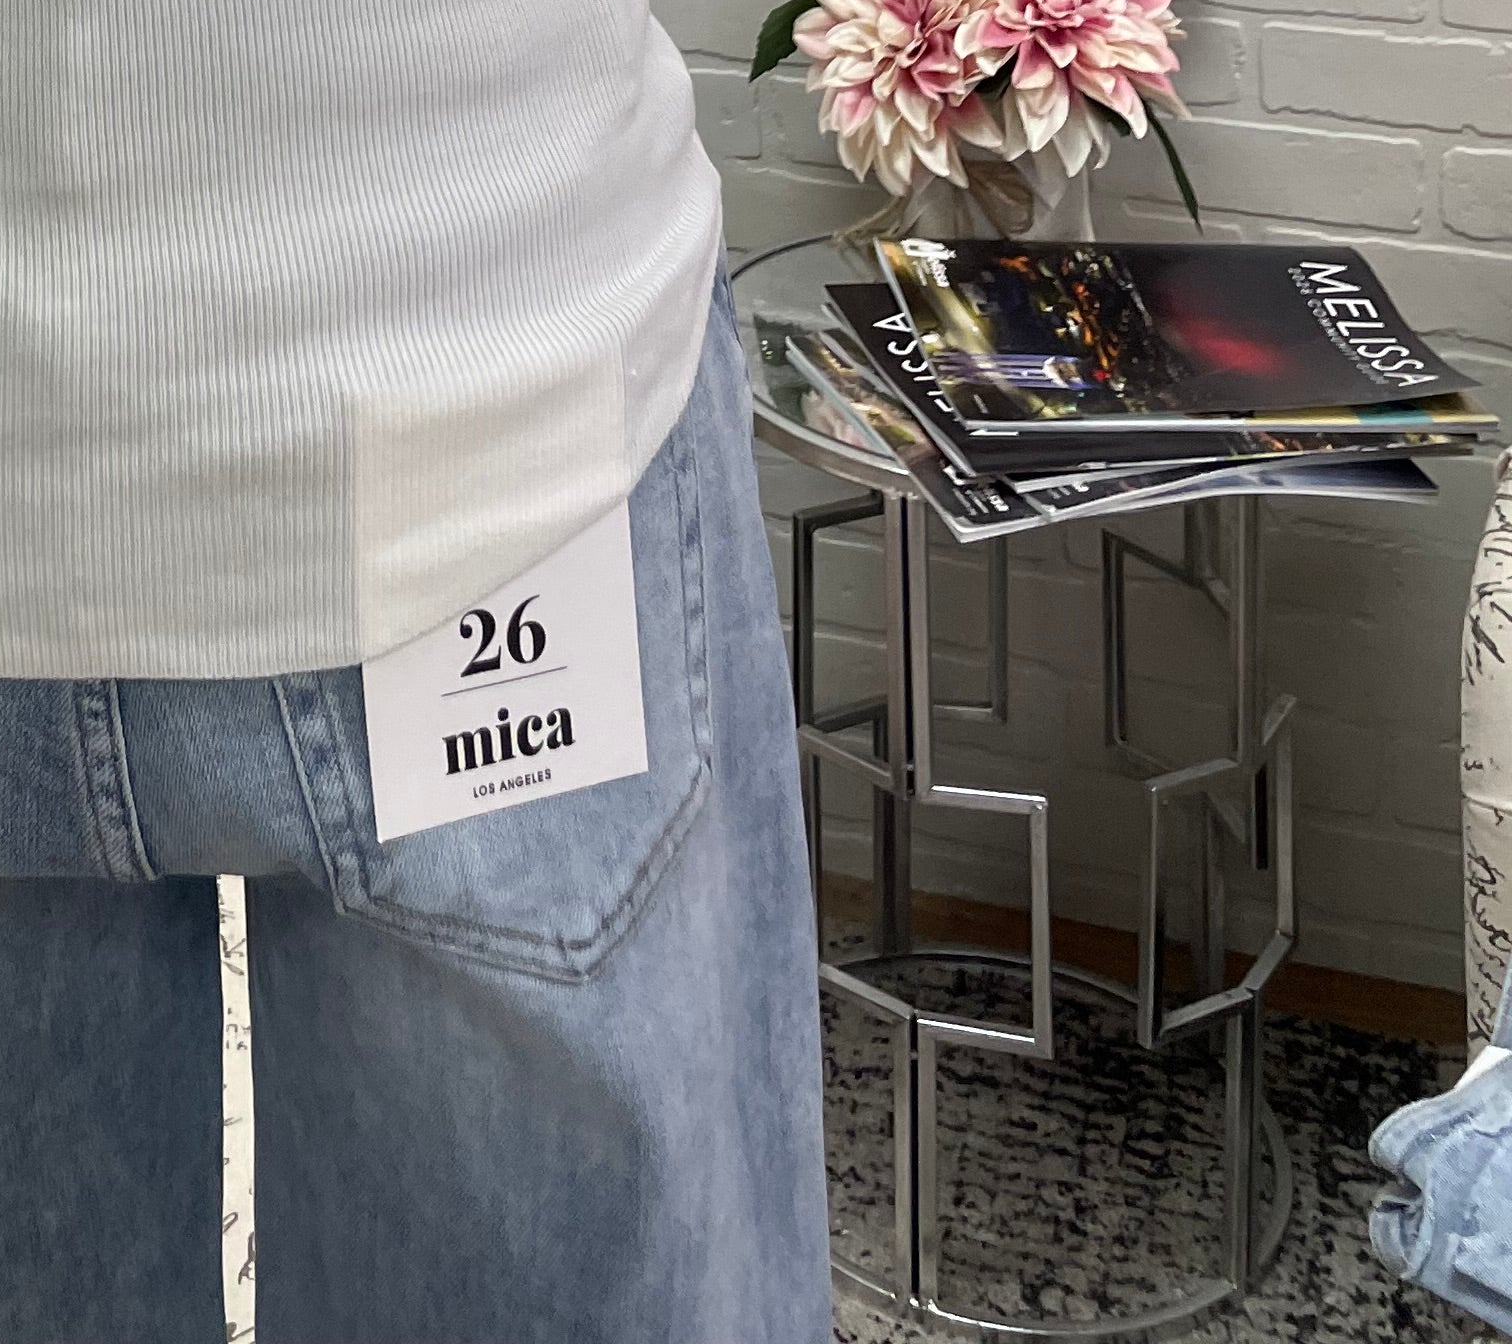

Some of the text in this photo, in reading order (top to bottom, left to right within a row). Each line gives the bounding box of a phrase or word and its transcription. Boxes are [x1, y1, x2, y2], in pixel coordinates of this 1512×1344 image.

[1299, 261, 1439, 387] MELISSA
[459, 594, 547, 678] 26
[442, 707, 576, 776] mica
[473, 768, 552, 799] LOS ANGELES
